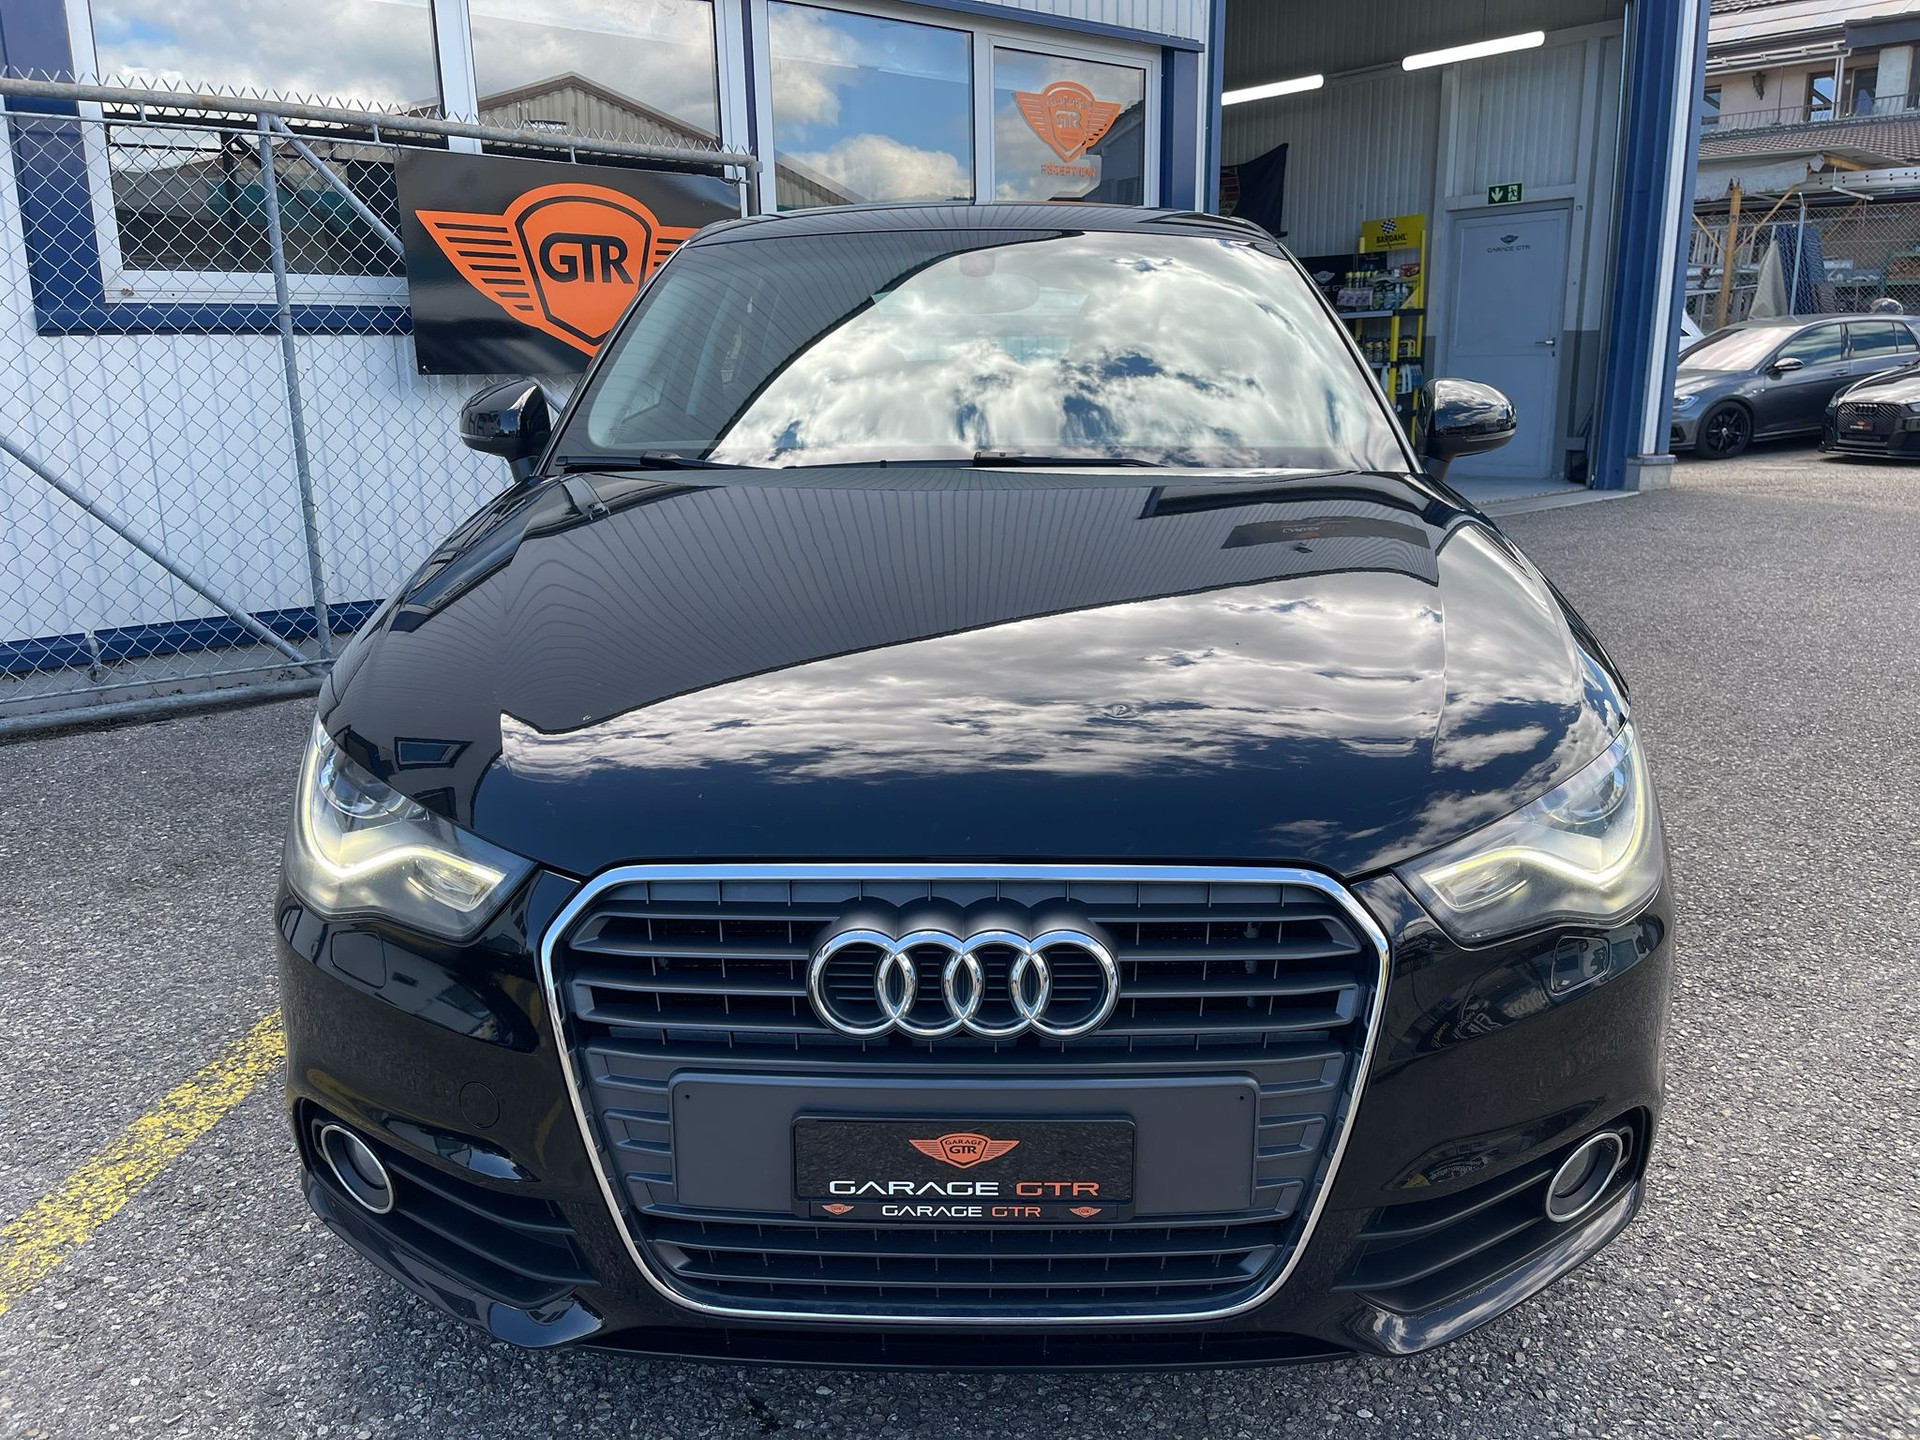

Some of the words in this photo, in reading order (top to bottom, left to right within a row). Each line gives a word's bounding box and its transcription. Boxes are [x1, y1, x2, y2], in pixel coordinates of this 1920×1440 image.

[1376, 234, 1406, 243] BARDAHL
[539, 232, 634, 284] GTR
[949, 1145, 977, 1154] GTR
[829, 1180, 999, 1196] GARAGE
[1016, 1181, 1100, 1196] GTR
[882, 1205, 982, 1217] GARAGE
[991, 1206, 1041, 1217] GTR
